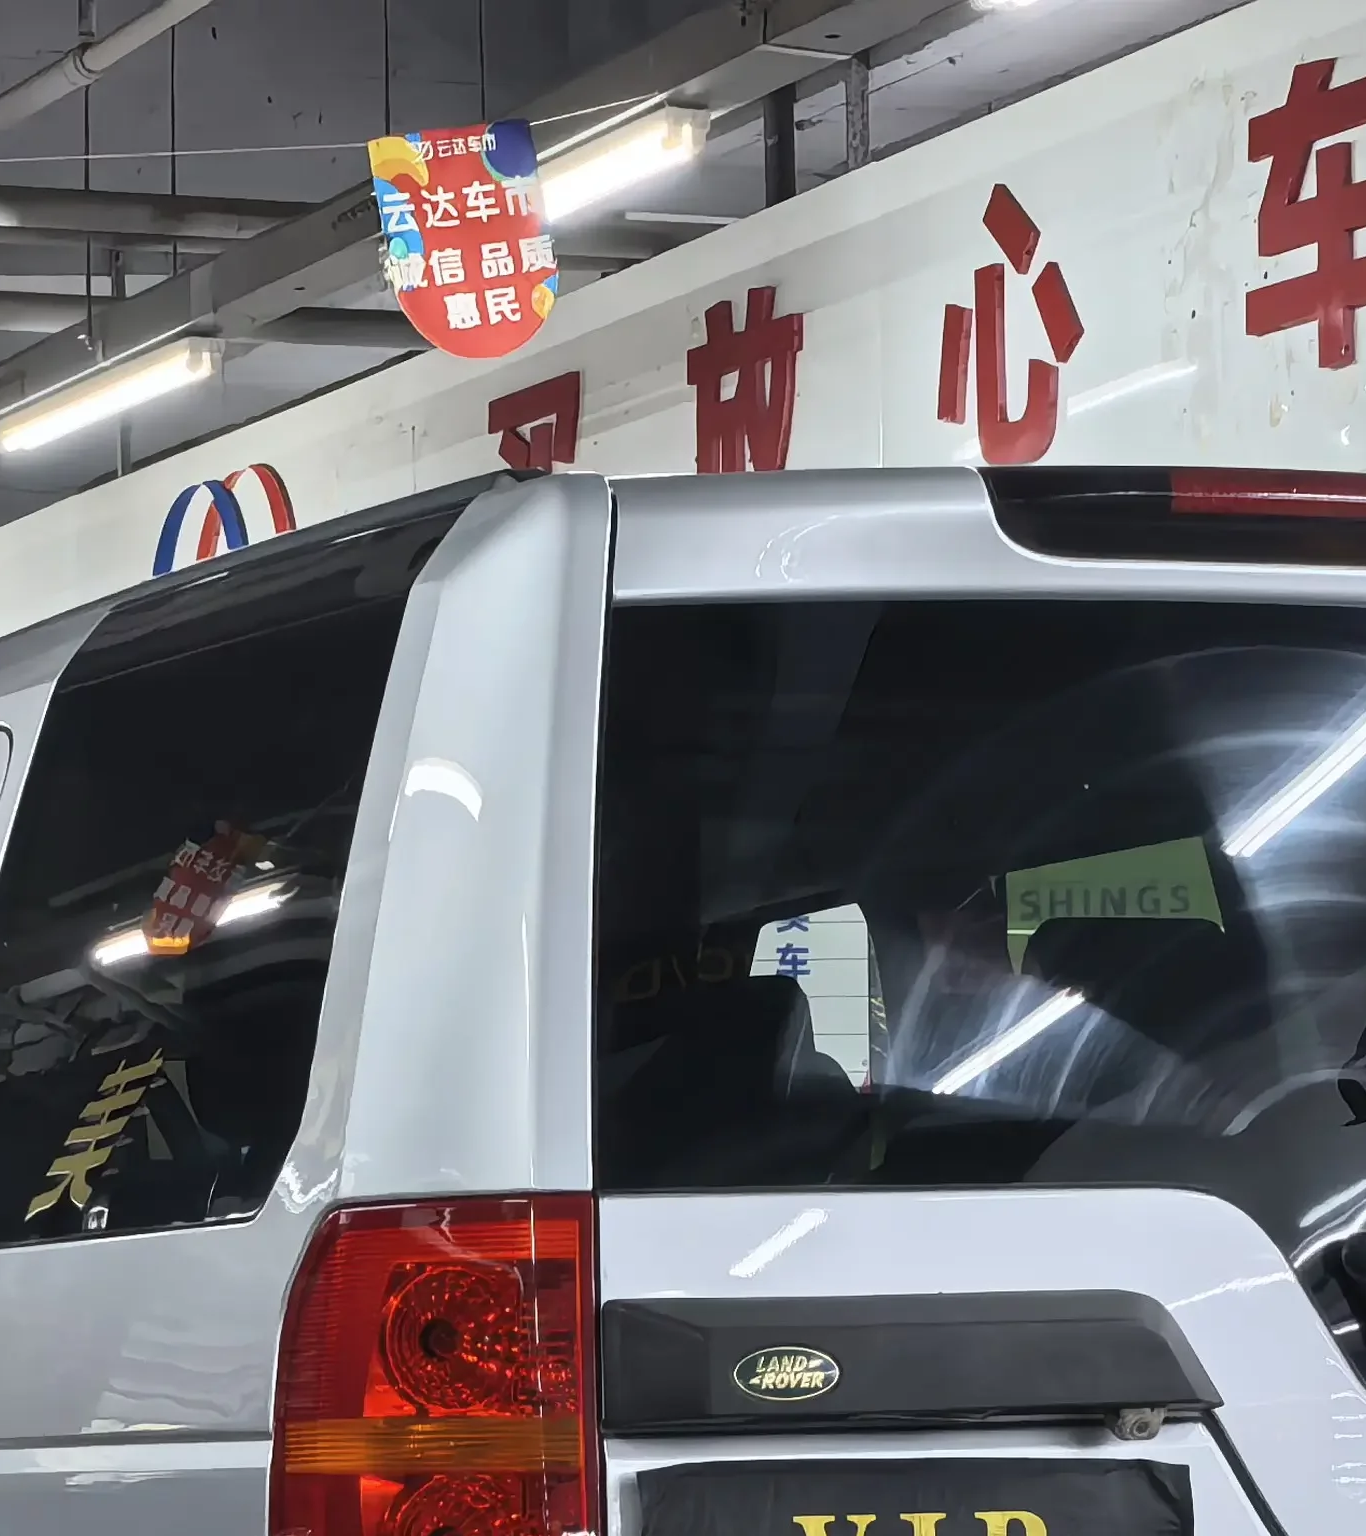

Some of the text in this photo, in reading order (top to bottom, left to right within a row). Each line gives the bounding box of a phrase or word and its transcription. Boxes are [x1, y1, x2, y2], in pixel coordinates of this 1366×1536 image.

[383, 175, 535, 233] 云达车市
[480, 234, 557, 279] 品质
[443, 286, 521, 329] 惠民
[755, 1355, 808, 1372] LAND
[761, 1371, 825, 1390] ROVER
